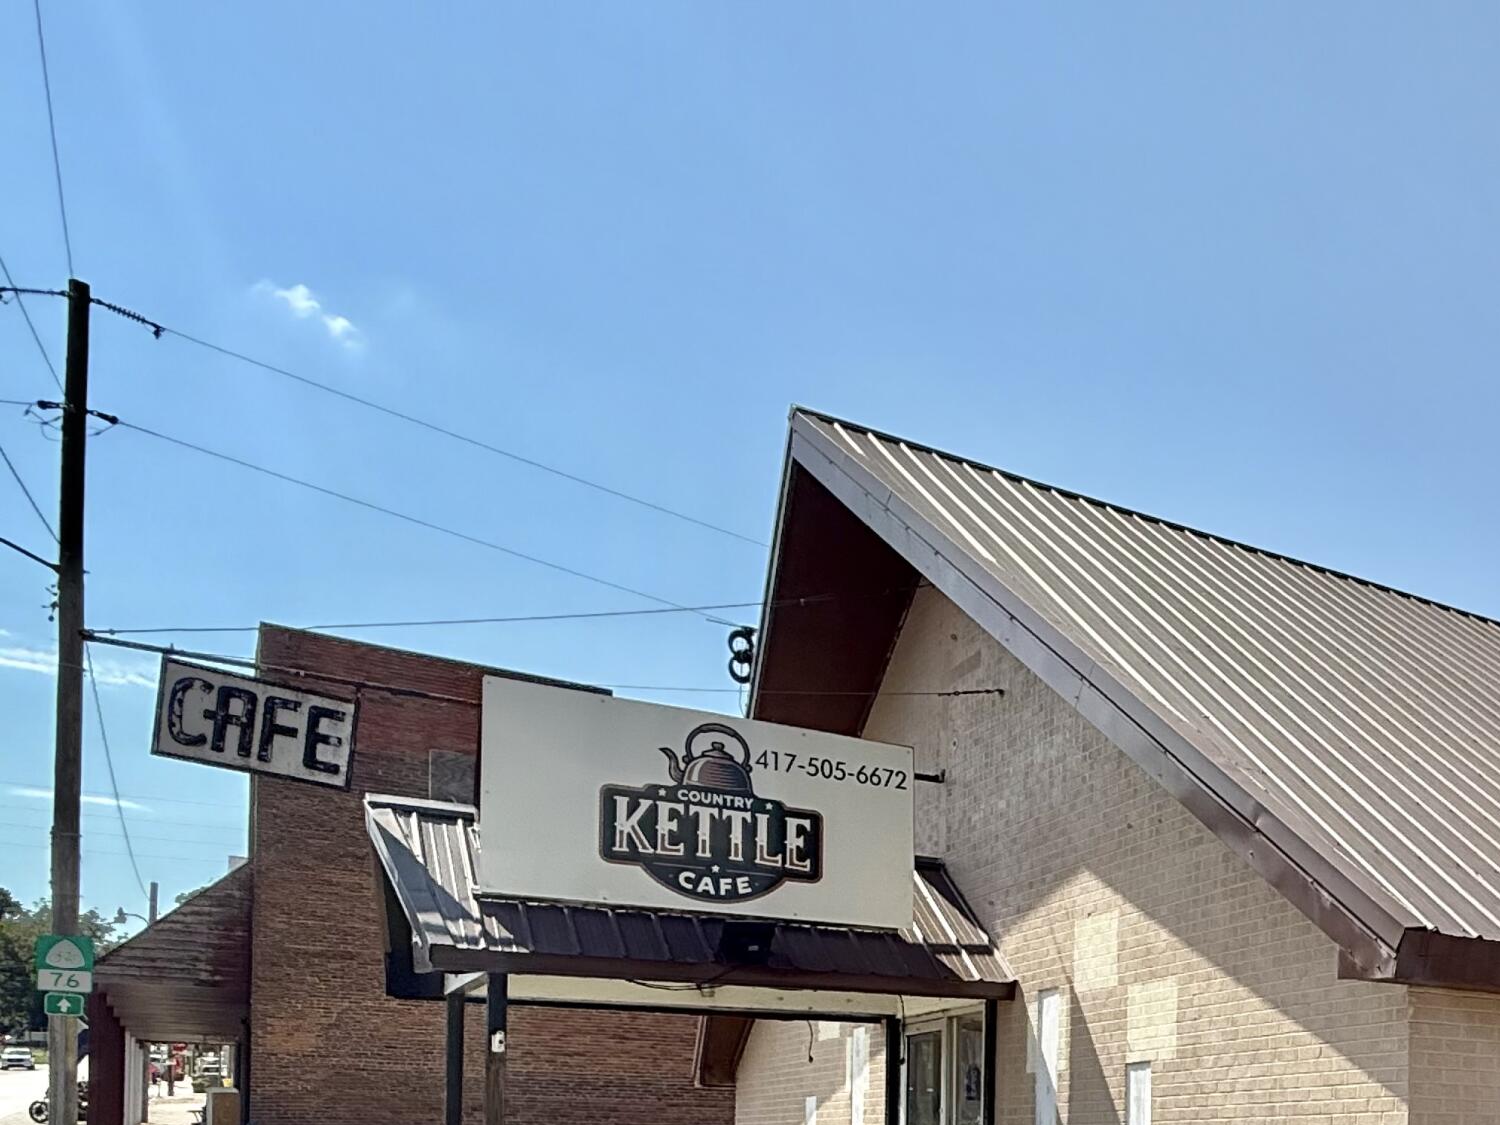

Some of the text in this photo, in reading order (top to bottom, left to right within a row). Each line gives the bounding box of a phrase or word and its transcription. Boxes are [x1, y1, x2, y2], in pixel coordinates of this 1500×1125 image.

[168, 677, 346, 775] CAFE
[755, 749, 908, 790] 417-505-6672
[677, 789, 755, 808] COUNTRY
[611, 795, 812, 871] KETTLE
[678, 870, 753, 896] CAFE
[49, 972, 79, 988] 76
